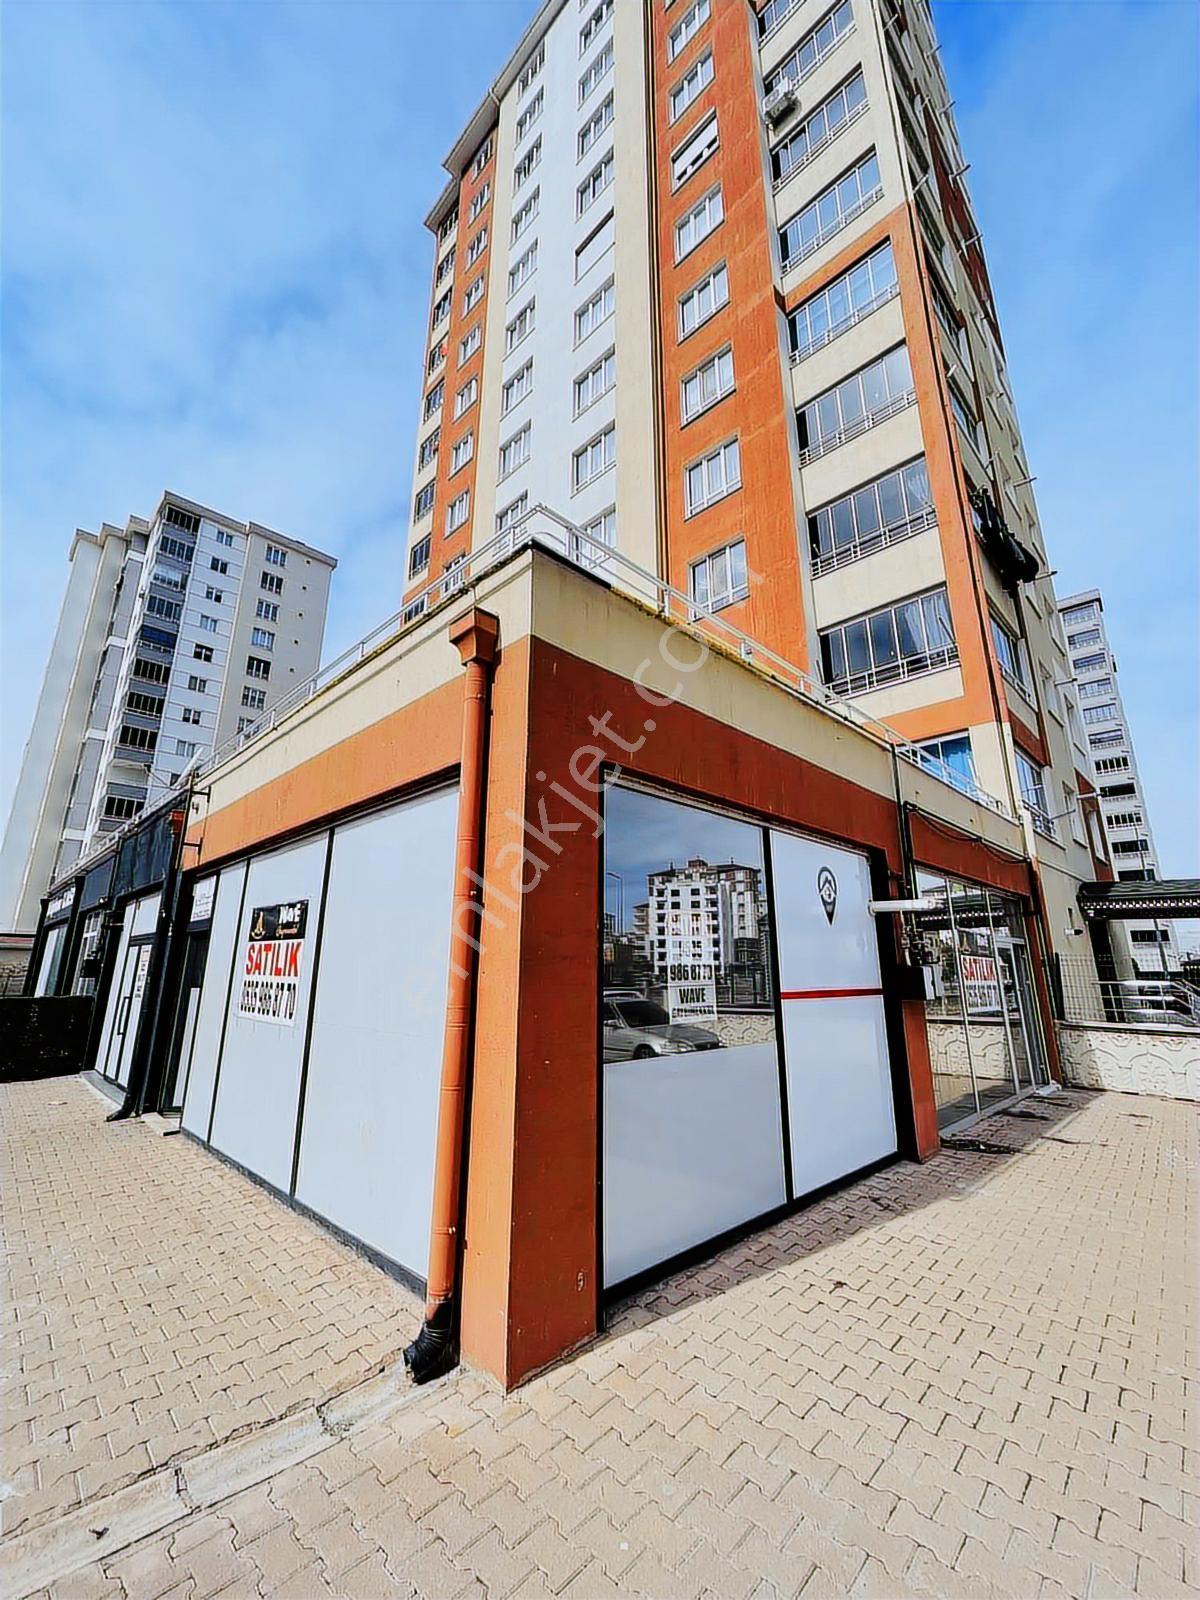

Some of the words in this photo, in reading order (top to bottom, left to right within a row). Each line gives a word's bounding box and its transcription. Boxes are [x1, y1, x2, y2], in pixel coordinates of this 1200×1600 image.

[246, 942, 302, 977] SATILIK
[670, 963, 690, 982] 986
[678, 988, 706, 1004] WAVE
